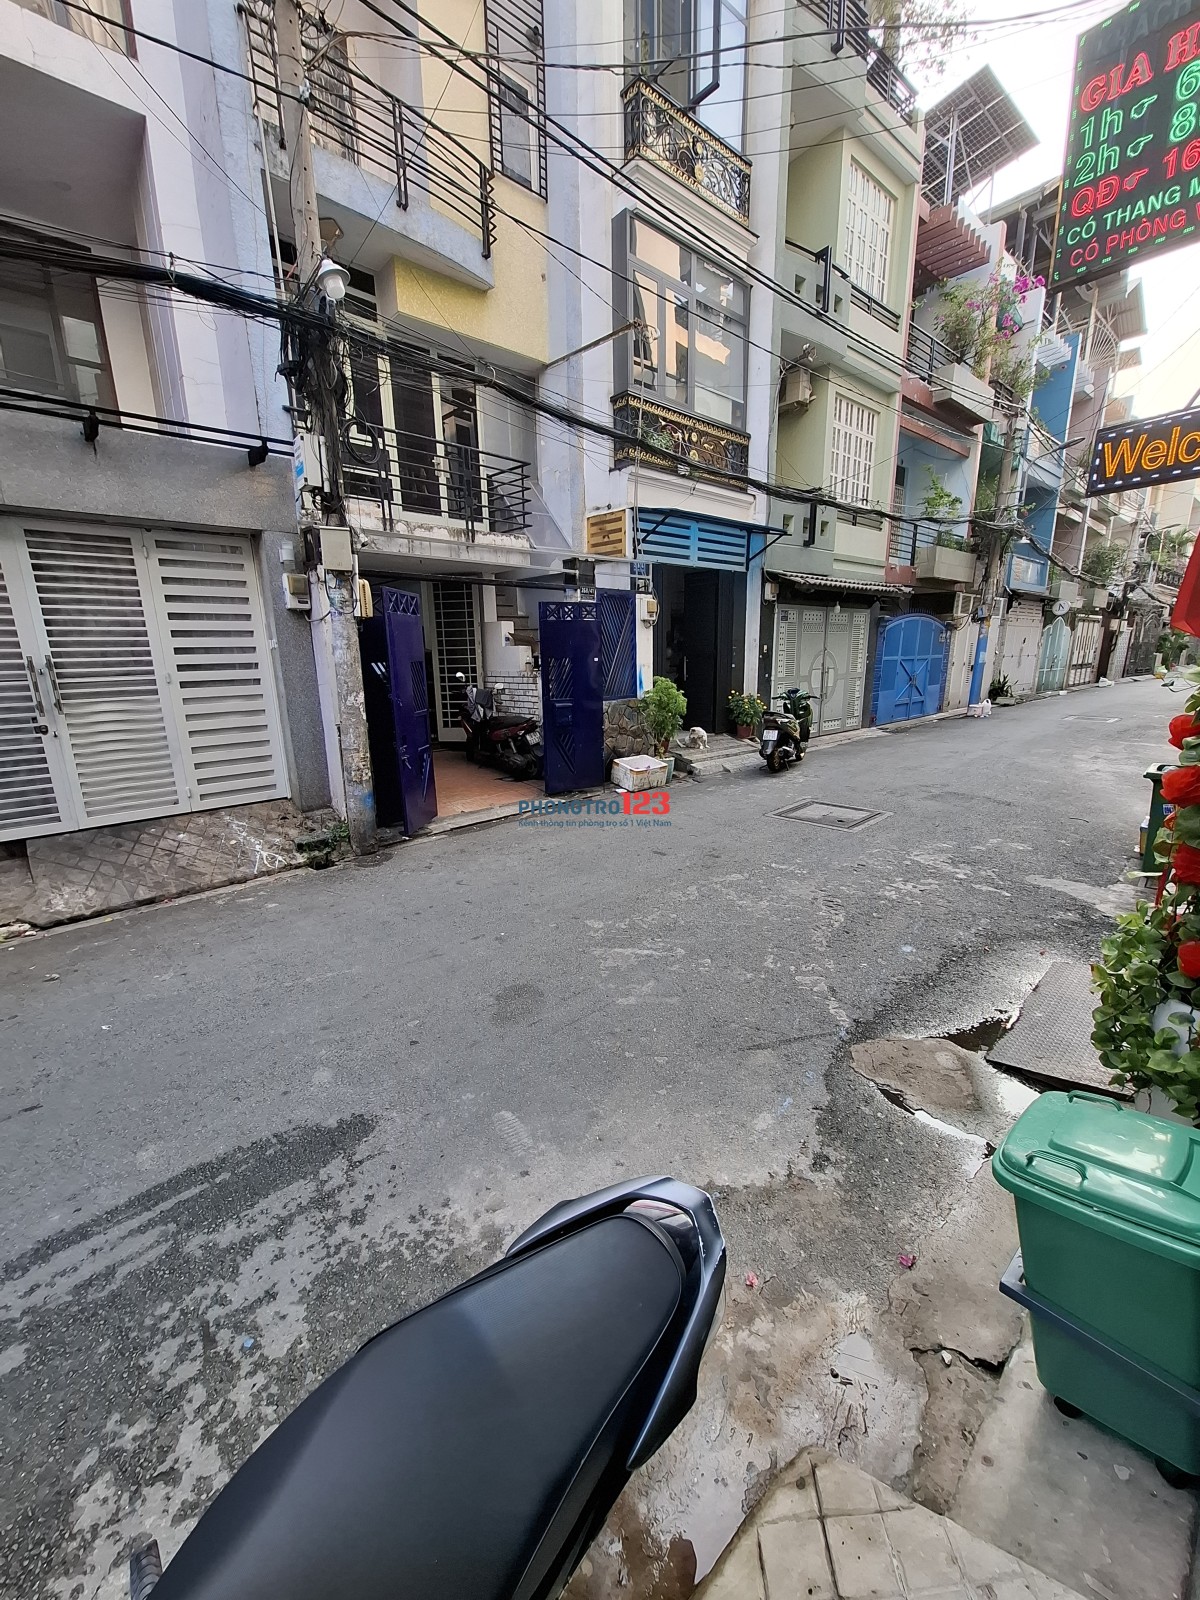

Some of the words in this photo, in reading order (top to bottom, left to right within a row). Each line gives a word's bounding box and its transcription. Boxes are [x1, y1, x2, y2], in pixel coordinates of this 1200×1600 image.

[1080, 51, 1154, 112] GIA
[1163, 20, 1200, 72] H
[1080, 107, 1123, 149] 1h
[1073, 143, 1120, 188] 2h
[1066, 215, 1097, 245] CÓ
[1102, 185, 1181, 230] THANG
[1071, 175, 1121, 217] QĐ
[1069, 237, 1099, 267] CÓ
[1105, 208, 1187, 255] PHÒNG
